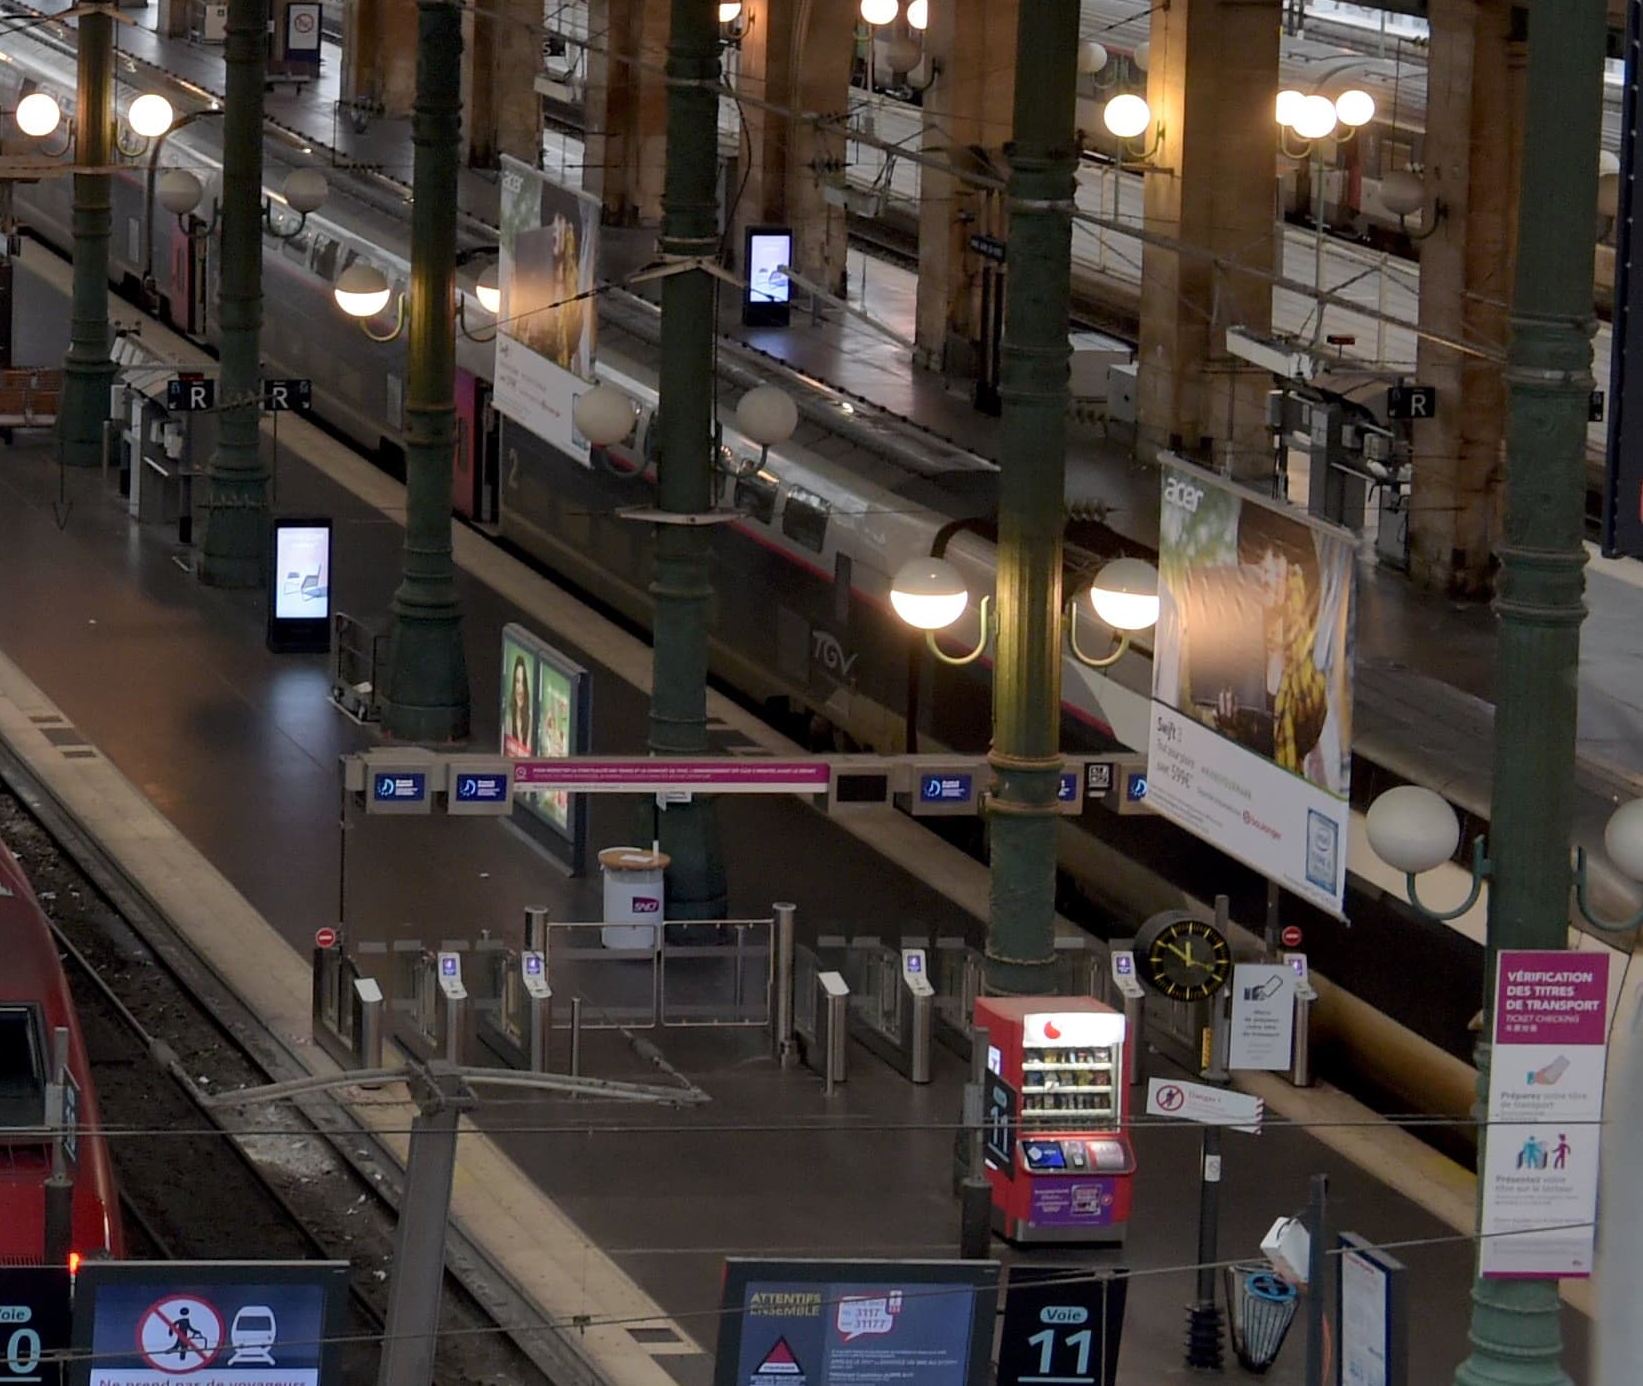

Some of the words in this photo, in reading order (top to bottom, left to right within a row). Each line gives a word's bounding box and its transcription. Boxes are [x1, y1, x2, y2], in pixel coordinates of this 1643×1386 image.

[1164, 476, 1204, 514] acer
[811, 630, 858, 676] TGV
[1507, 970, 1593, 983] VÉRIFICATION
[1506, 985, 1531, 997] DES
[1534, 985, 1575, 997] TITRES
[1506, 999, 1524, 1011] DE
[1526, 1000, 1600, 1012] TRANSPORT
[1047, 1309, 1082, 1321] Voie
[1027, 1329, 1093, 1374] 11
